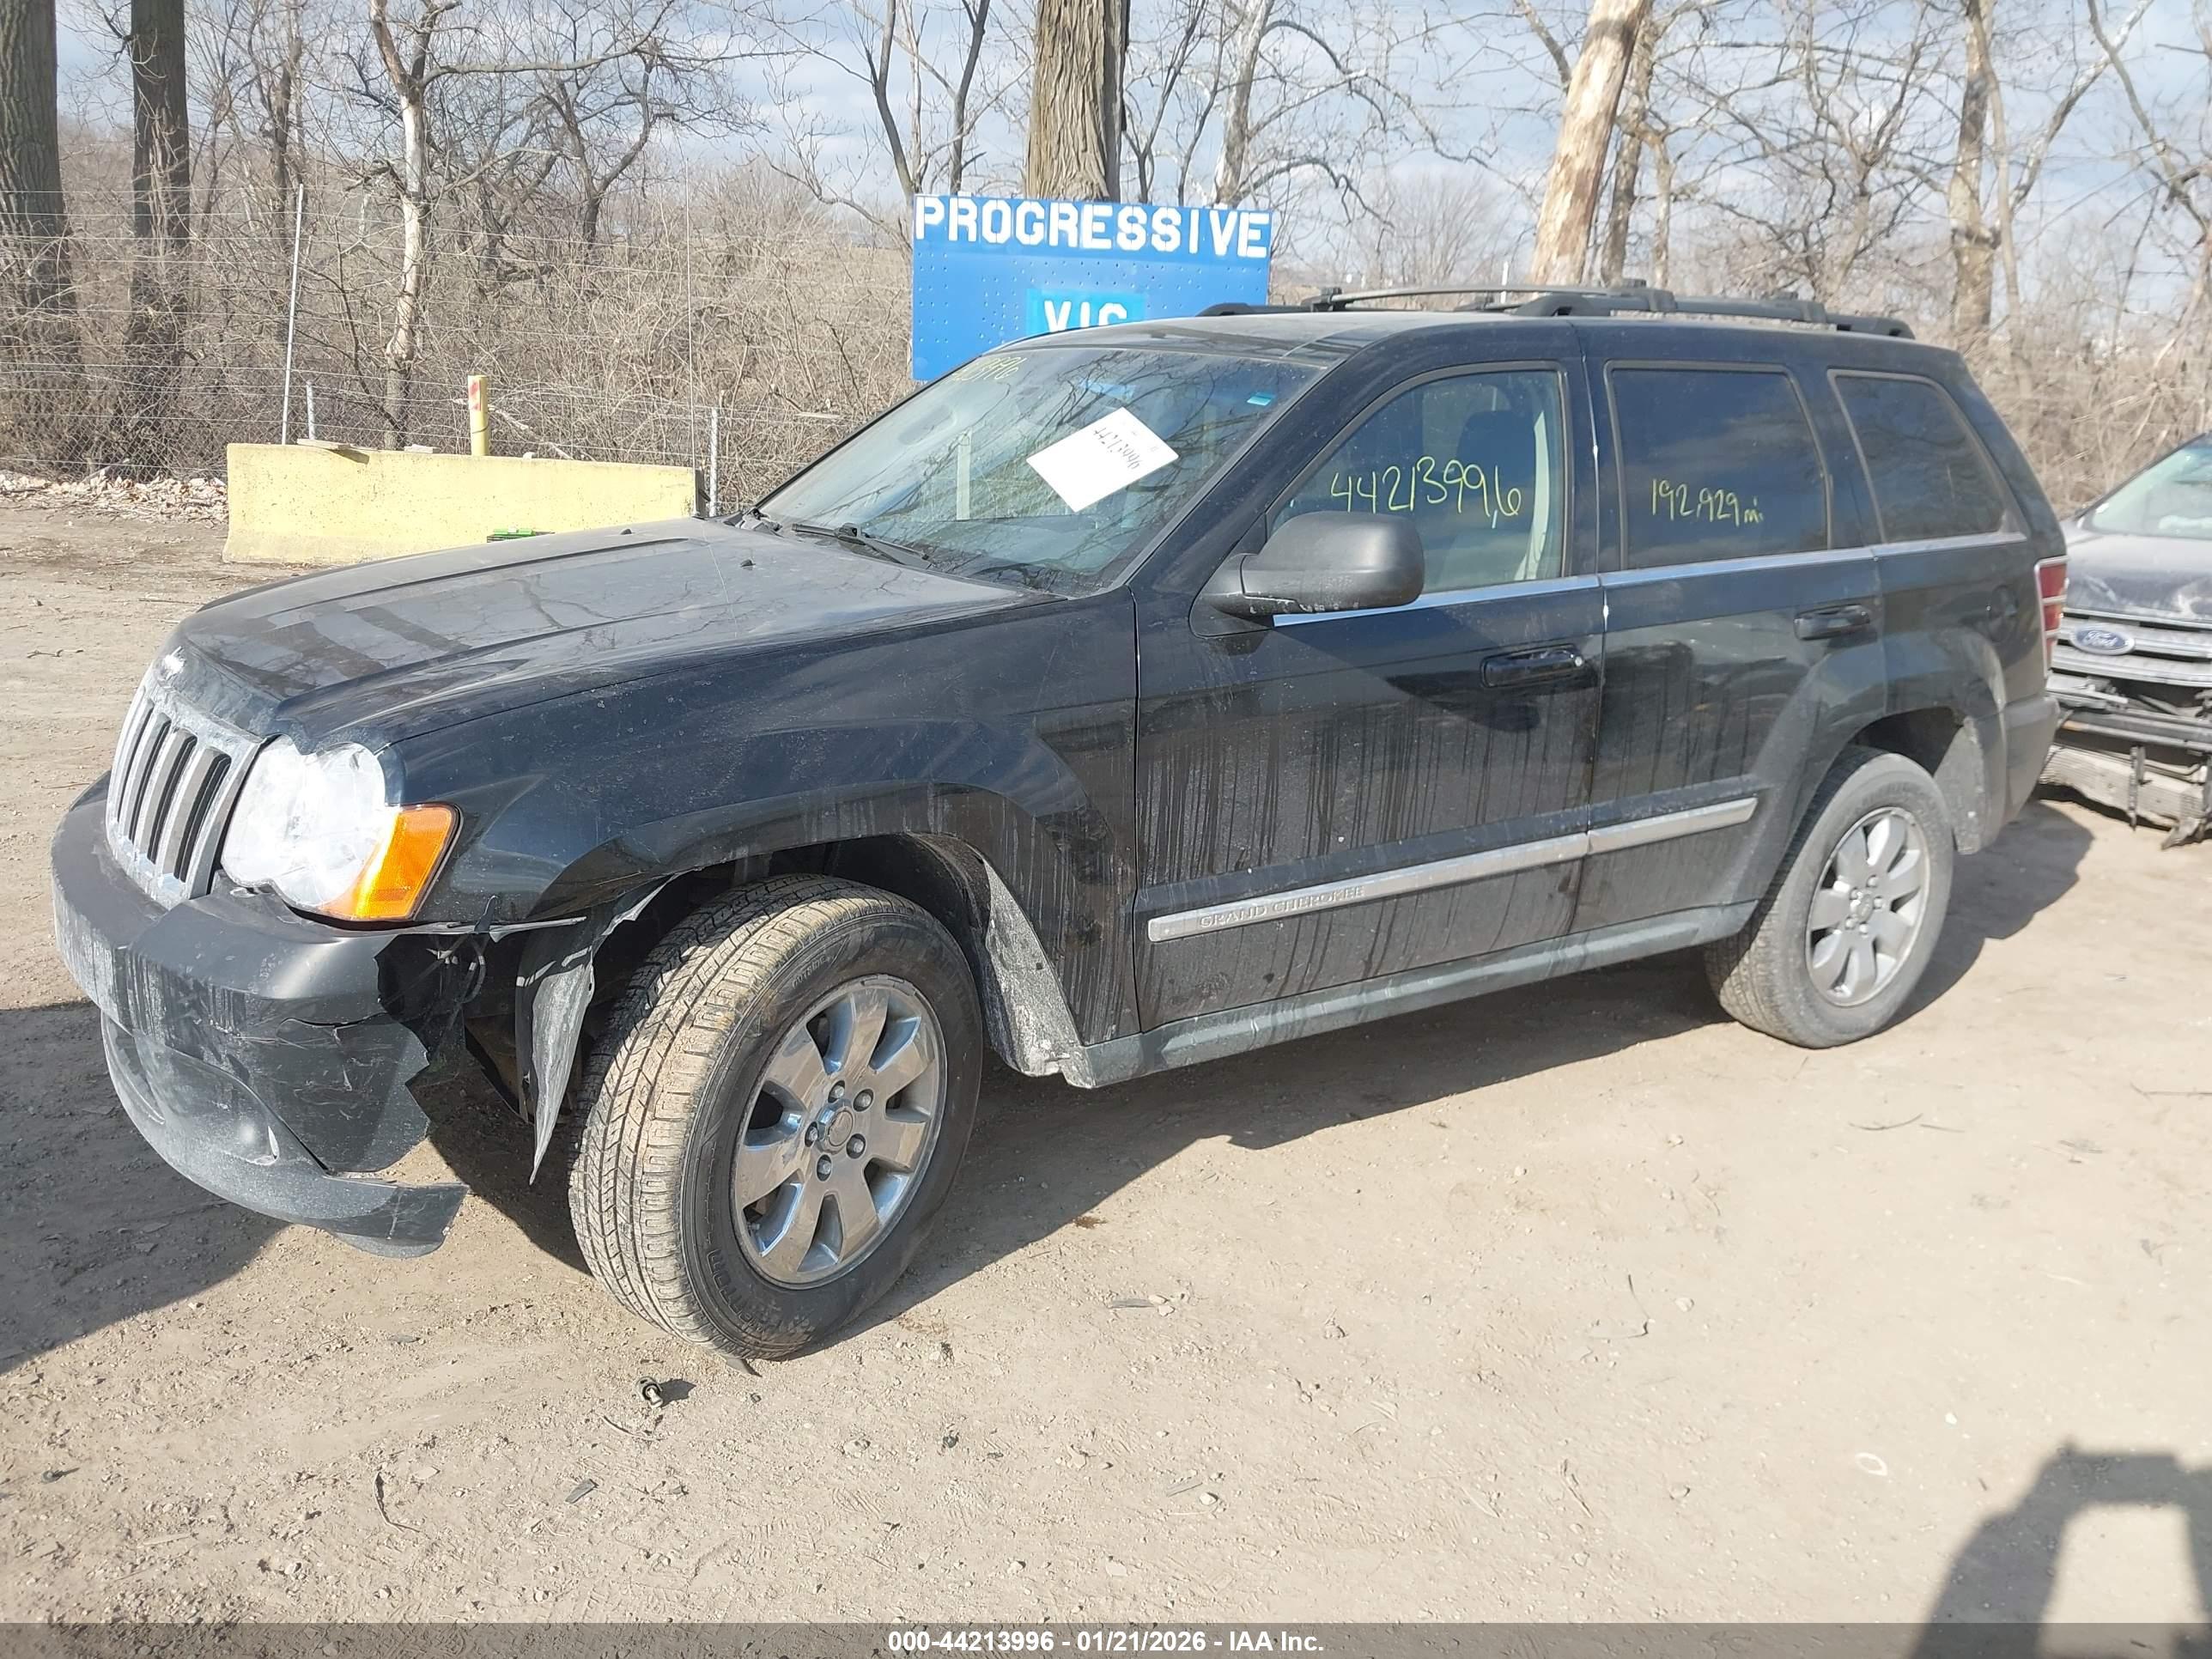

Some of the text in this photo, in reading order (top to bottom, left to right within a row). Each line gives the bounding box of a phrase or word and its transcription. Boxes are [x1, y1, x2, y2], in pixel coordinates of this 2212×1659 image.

[915, 196, 1270, 258] PROGRESSIVE
[1652, 478, 1740, 527] 192,929
[2085, 629, 2119, 647] Ford
[1200, 884, 1365, 928] GRAND CHEROKEE
